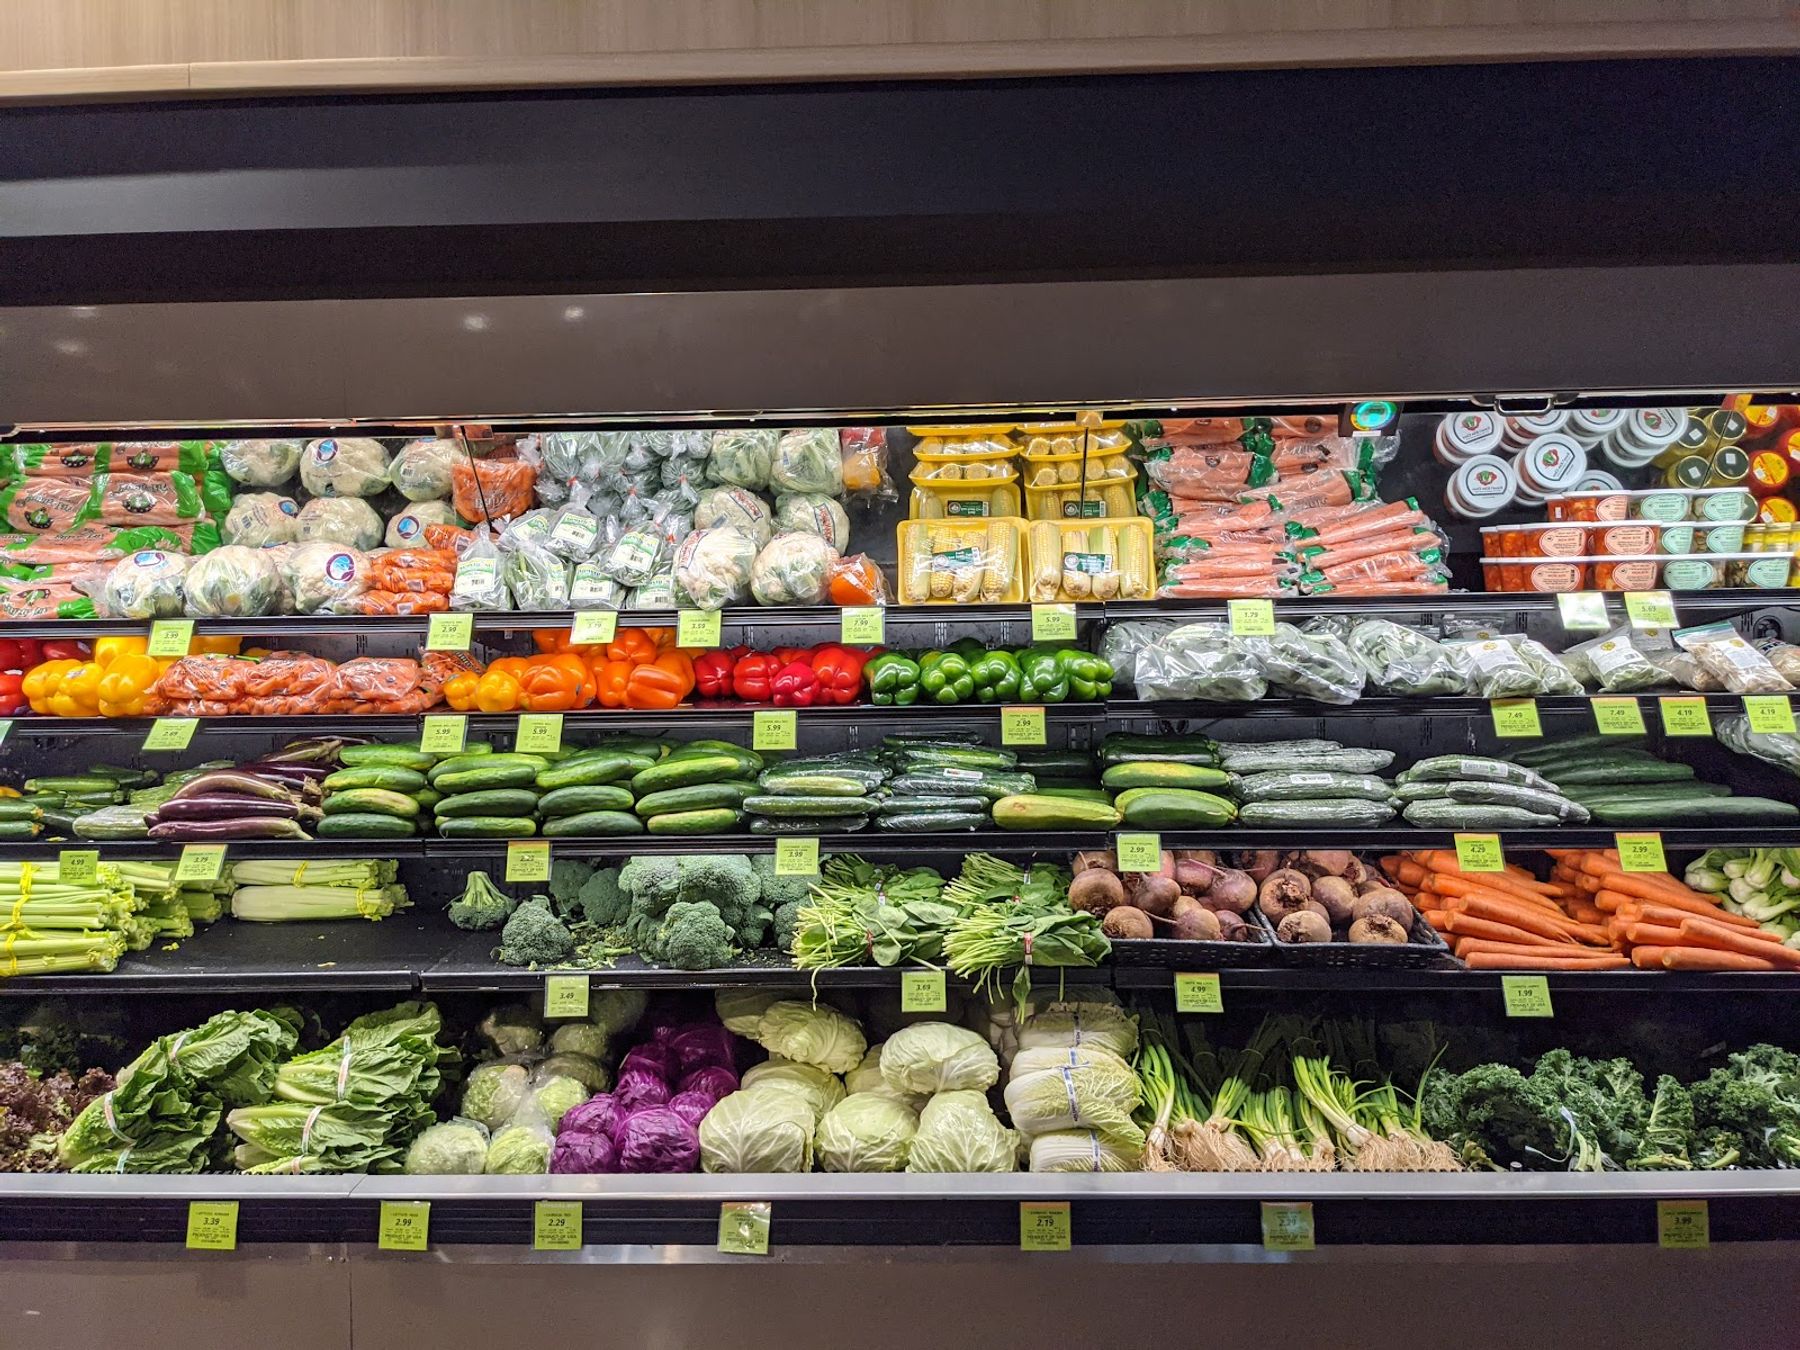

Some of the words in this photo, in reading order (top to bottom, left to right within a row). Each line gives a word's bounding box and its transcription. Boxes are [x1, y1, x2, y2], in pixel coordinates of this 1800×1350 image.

[203, 1217, 220, 1225] 3.39
[395, 1218, 412, 1226] 2.99
[548, 1218, 565, 1226] 2.29
[1036, 1219, 1054, 1227] 2.19
